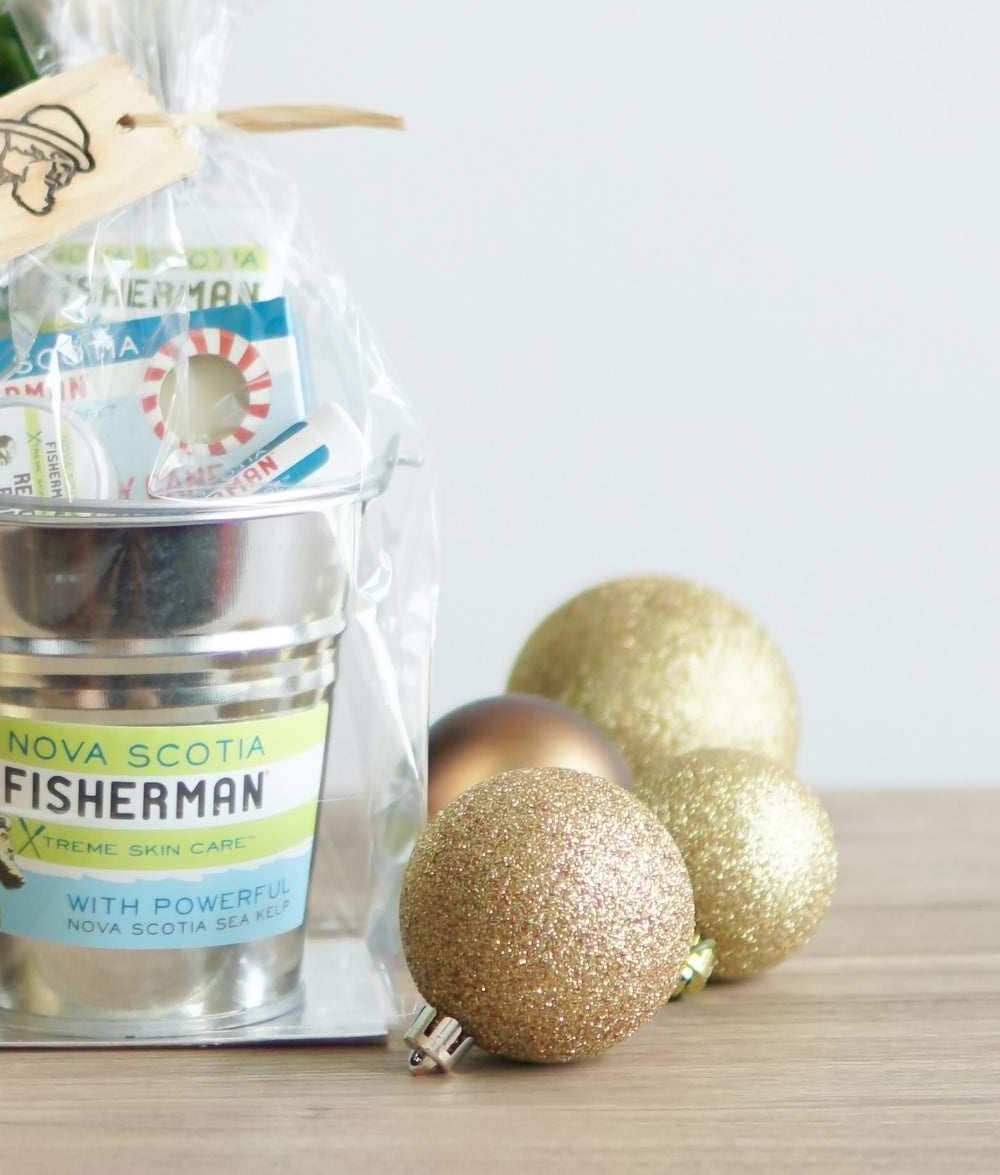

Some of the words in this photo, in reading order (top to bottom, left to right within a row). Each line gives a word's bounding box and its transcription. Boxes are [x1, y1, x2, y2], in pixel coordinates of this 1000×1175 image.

[46, 441, 63, 498] FISHERM
[8, 730, 108, 766] NOVA
[127, 735, 266, 769] SCOTIA
[3, 765, 265, 821] FISHERMAN
[16, 816, 118, 859] XTREME
[129, 843, 180, 857] SKIN
[67, 893, 139, 917] WITH
[154, 877, 291, 916] POWERFUL
[67, 918, 121, 936] NOVA
[132, 920, 207, 936] SCOTIA
[215, 913, 251, 931] SEA
[256, 898, 291, 924] KELP
